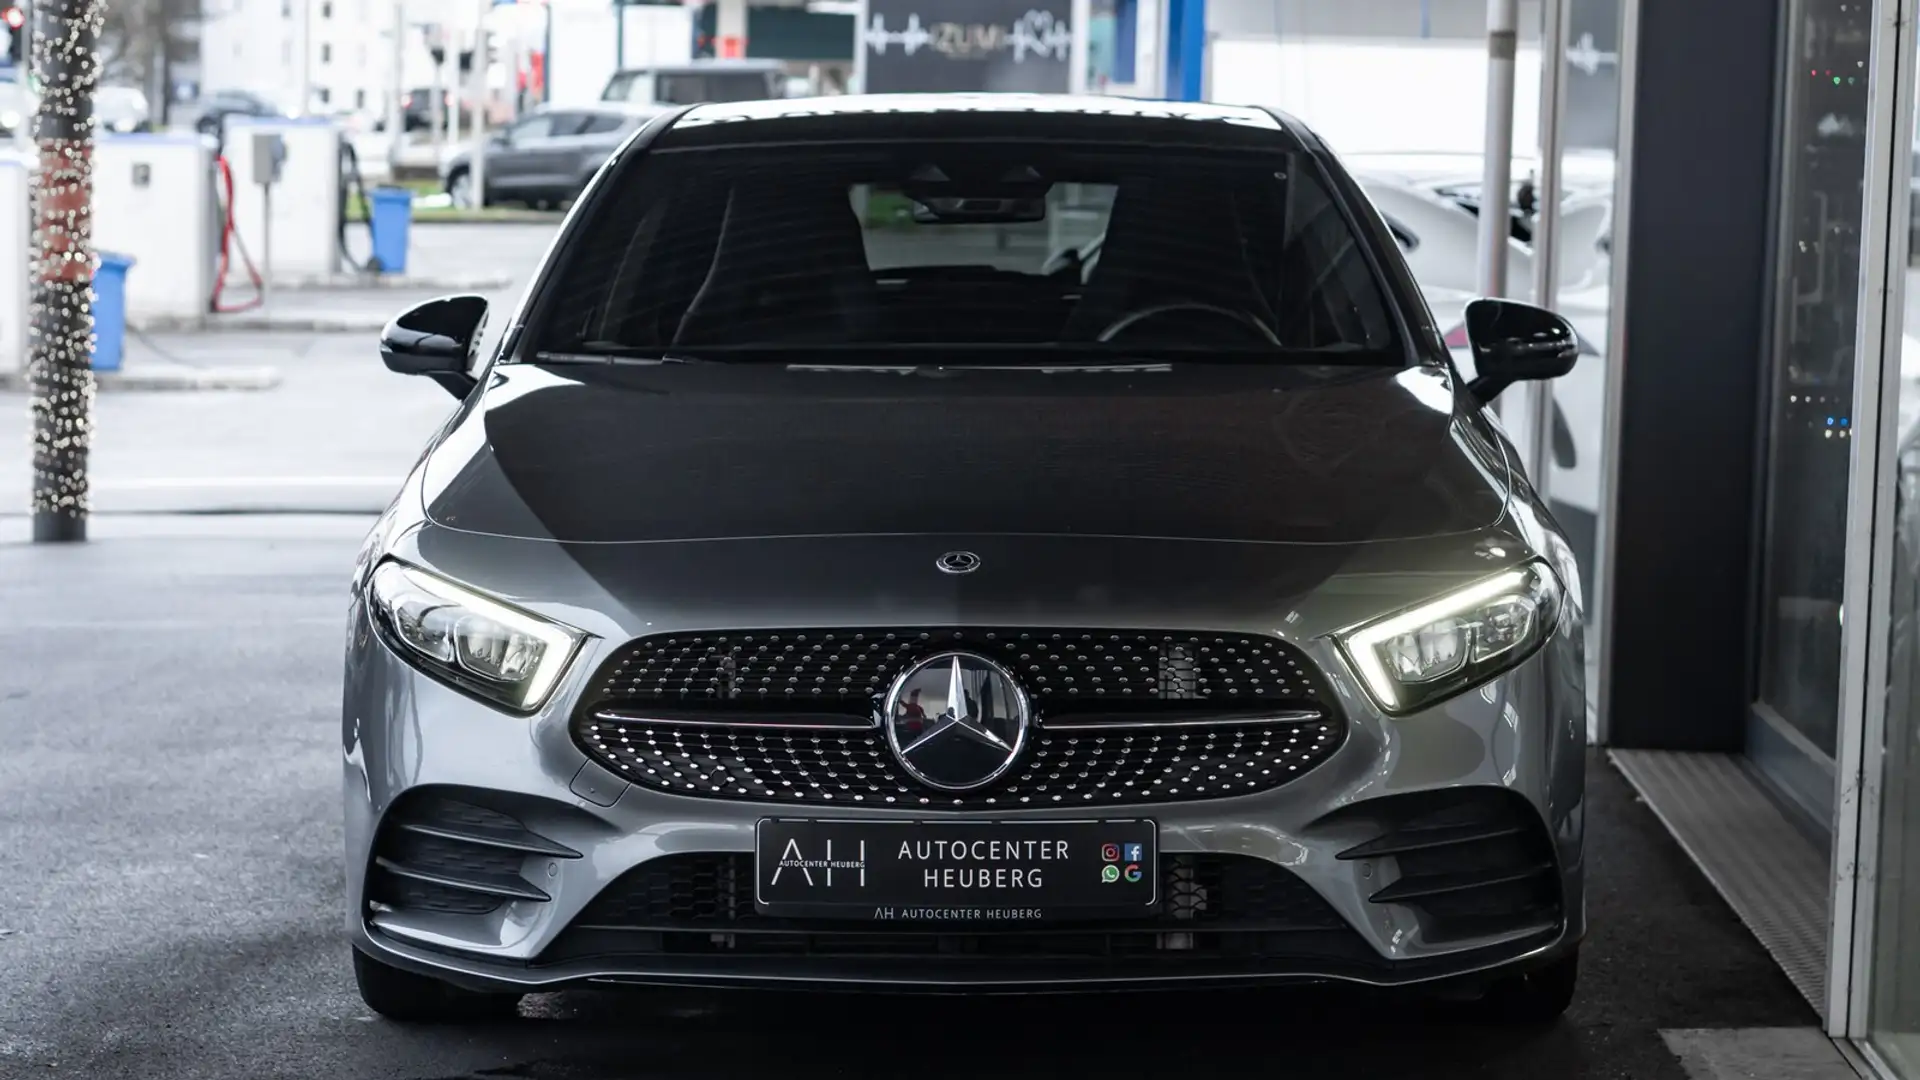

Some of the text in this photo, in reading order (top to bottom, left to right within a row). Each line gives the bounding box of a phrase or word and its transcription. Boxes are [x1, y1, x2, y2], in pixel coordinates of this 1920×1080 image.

[897, 840, 1069, 861] AUTOCENTER
[778, 860, 828, 868] AUTOCENTER
[924, 868, 1043, 888] HEUBERG
[901, 908, 981, 919] AUTOCENTER
[986, 908, 1042, 919] HEUBERG
